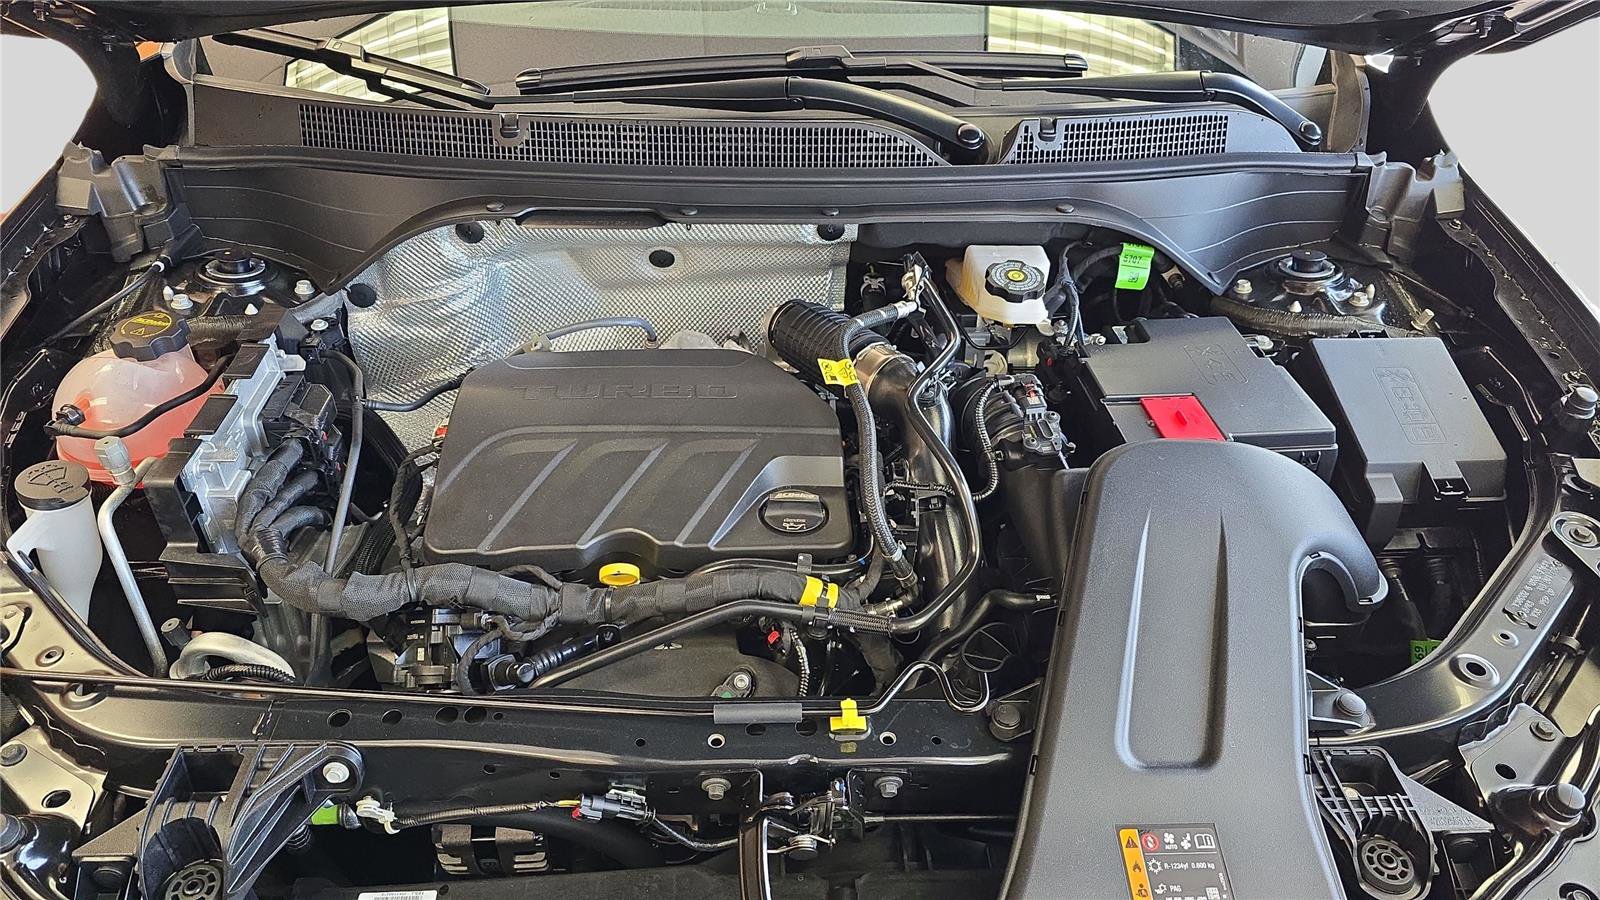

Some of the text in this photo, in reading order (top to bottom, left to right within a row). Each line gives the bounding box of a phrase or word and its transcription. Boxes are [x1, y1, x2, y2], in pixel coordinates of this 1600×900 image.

[511, 383, 738, 400] TURBO
[1207, 862, 1216, 870] kg
[1169, 885, 1183, 893] PAG
